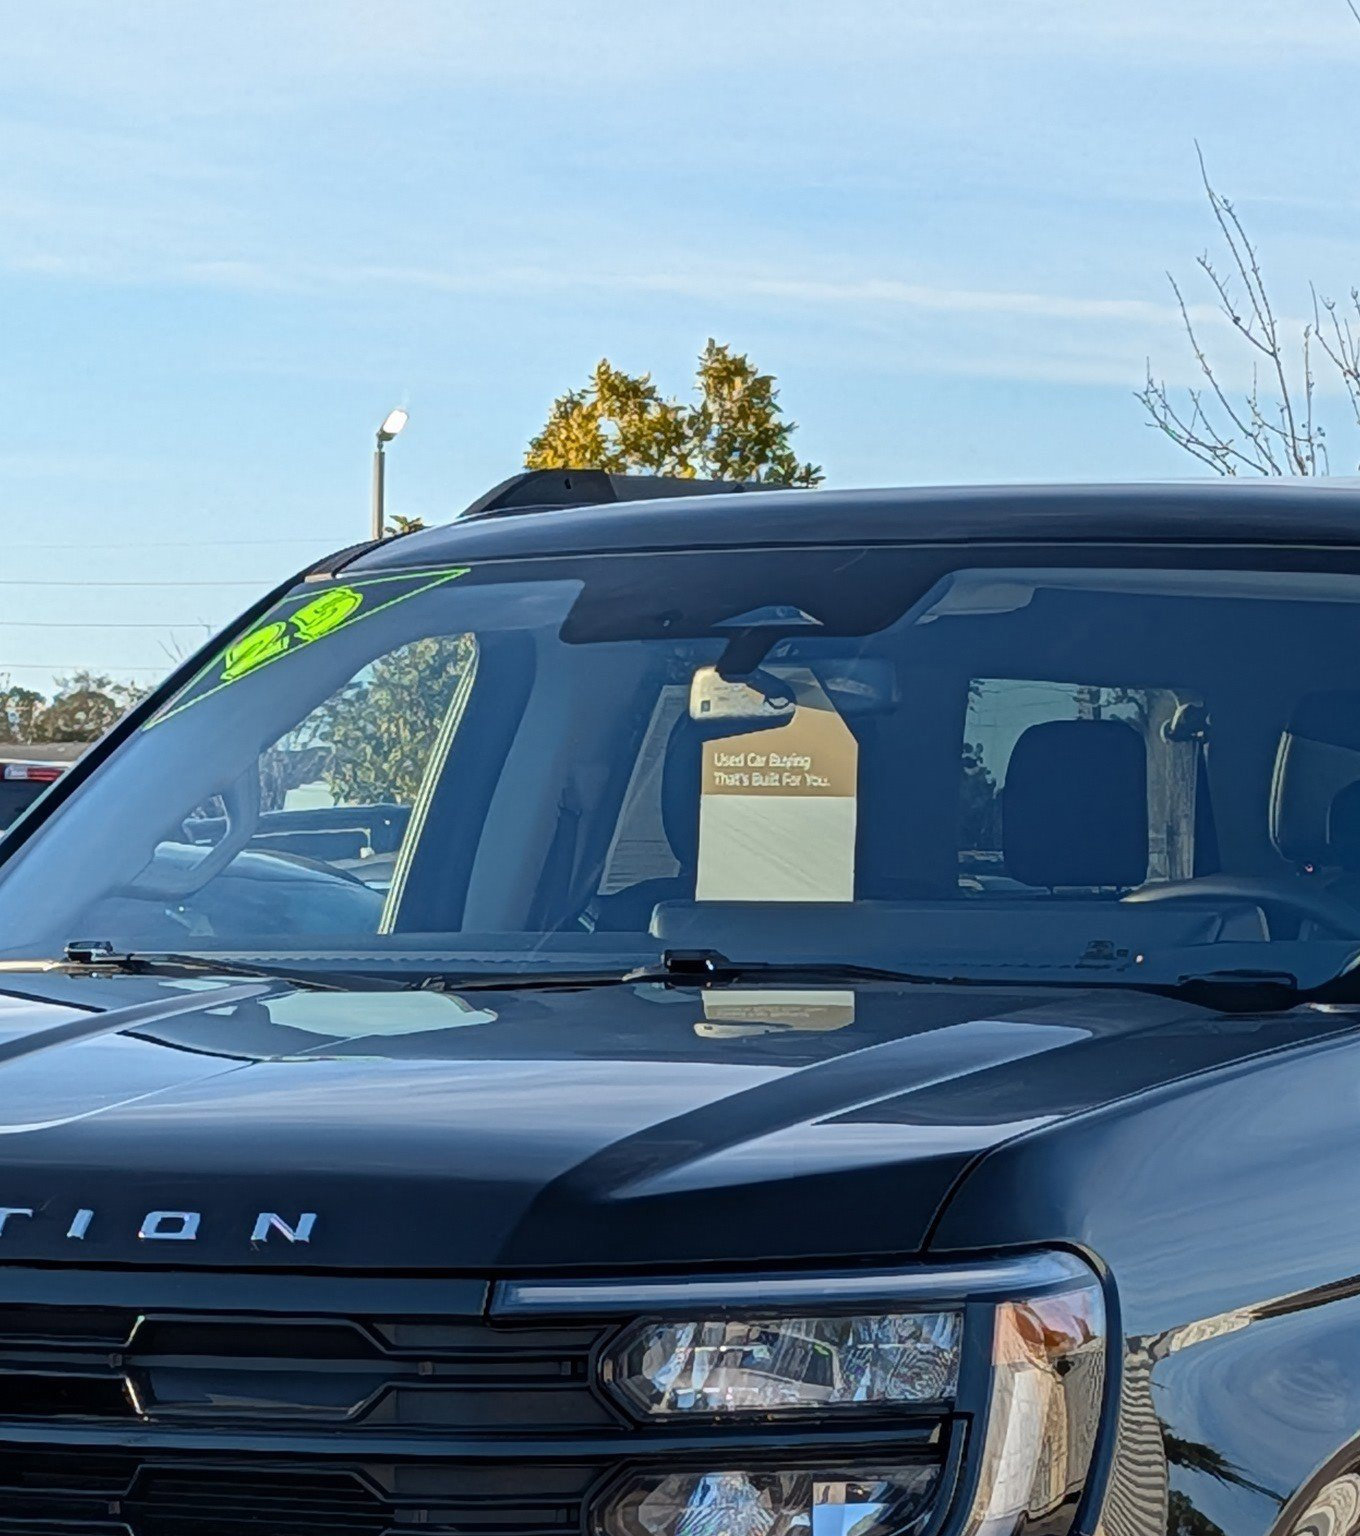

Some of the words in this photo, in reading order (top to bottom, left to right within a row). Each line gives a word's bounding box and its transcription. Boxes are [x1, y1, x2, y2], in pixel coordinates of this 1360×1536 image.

[714, 752, 745, 767] Used
[747, 752, 767, 767] Car
[769, 752, 811, 771] Buying
[714, 771, 749, 787] That's
[752, 772, 780, 787] Built
[782, 772, 801, 787] For
